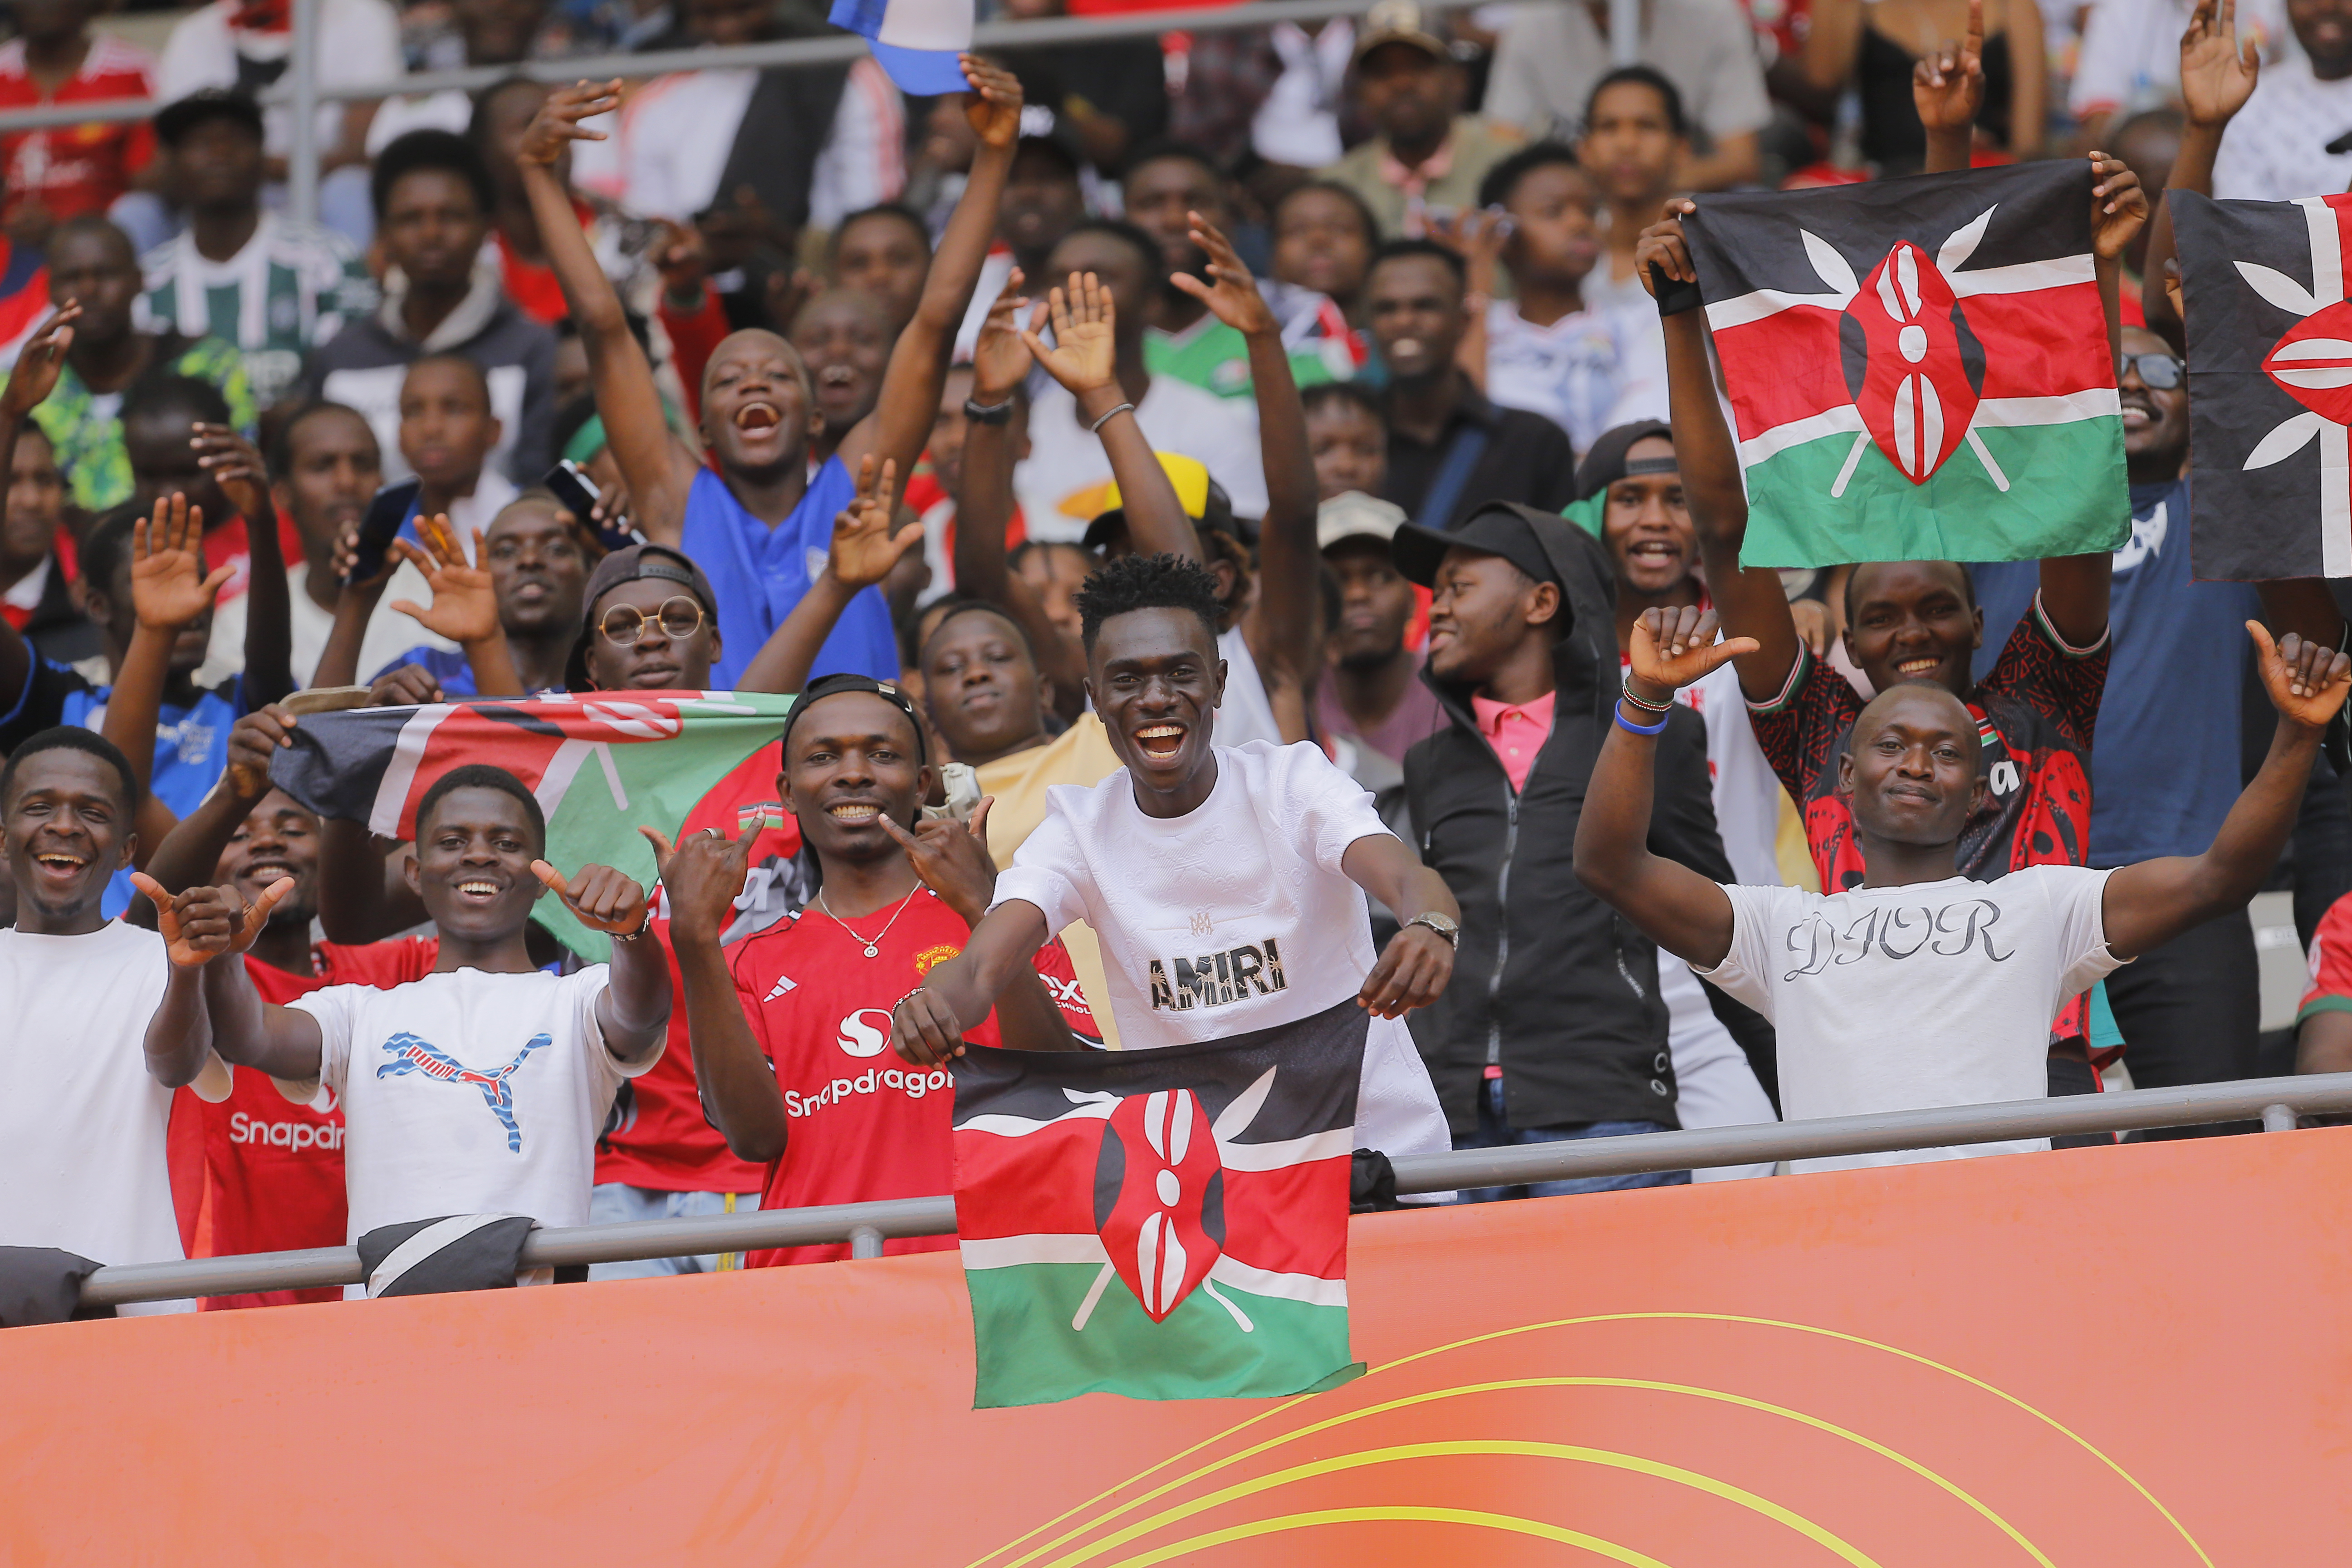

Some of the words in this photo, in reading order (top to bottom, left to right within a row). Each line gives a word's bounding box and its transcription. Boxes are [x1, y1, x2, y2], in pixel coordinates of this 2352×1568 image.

[920, 948, 960, 960] MANCHESTE
[1784, 899, 2015, 982] DIOR
[1149, 937, 1288, 1011] AMIRI
[405, 1045, 456, 1079] PUMA
[229, 1112, 345, 1153] Snapdr
